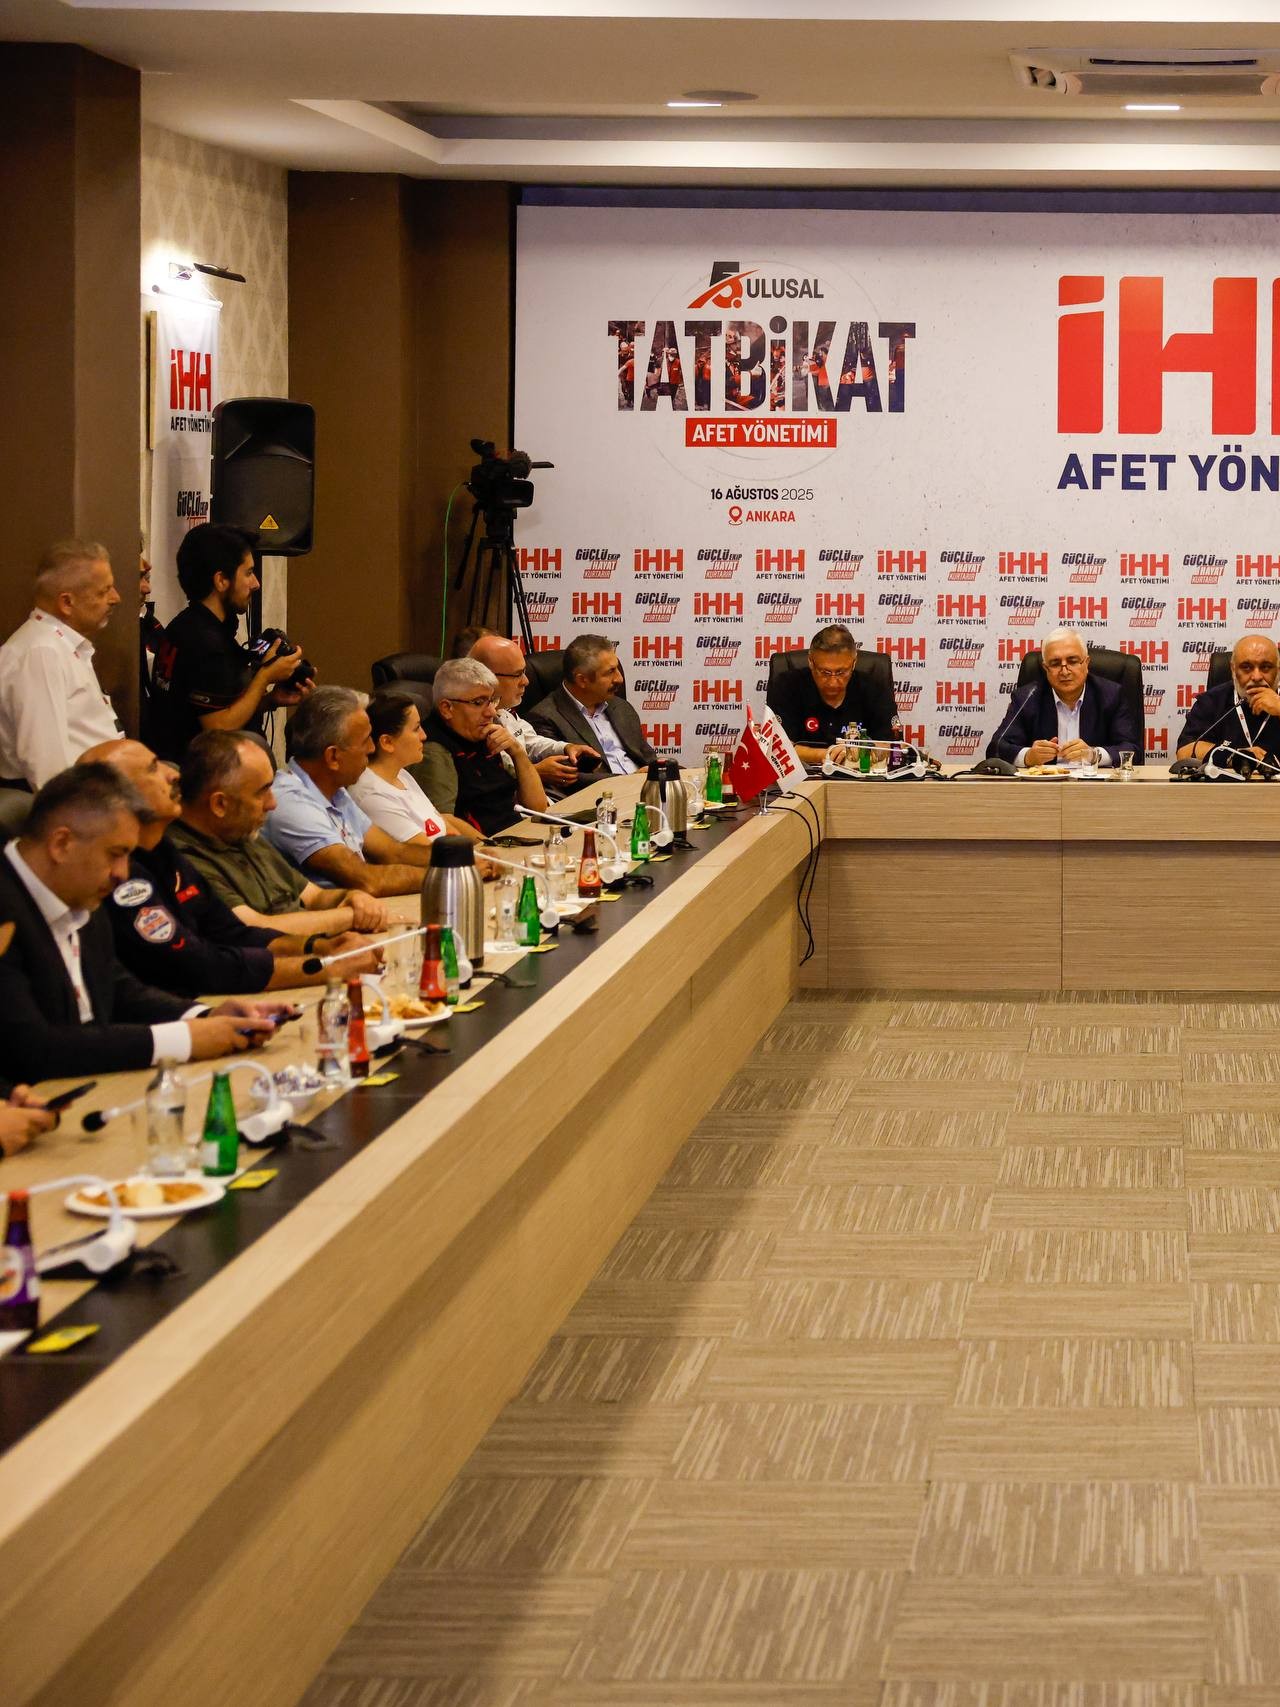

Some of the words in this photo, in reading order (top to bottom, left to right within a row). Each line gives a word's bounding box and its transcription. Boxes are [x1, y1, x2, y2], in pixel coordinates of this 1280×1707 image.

[746, 278, 824, 298] ULUSAL
[608, 316, 916, 412] TATBİKAT
[170, 416, 187, 431] AFET
[692, 424, 737, 442] AFET
[744, 420, 828, 442] YÖNETİMİ
[1057, 454, 1176, 491] AFET
[711, 488, 722, 500] 16
[726, 485, 779, 500] AĞUSTOS
[782, 489, 814, 500] 2025
[746, 510, 796, 522] ANKARA
[575, 549, 608, 562] GÜÇLÜ
[697, 549, 730, 562] GÜÇLÜ
[819, 550, 852, 562] GÜÇLÜ
[940, 551, 973, 564] GÜÇLÜ
[1061, 553, 1094, 566] GÜÇLÜ
[1183, 554, 1216, 566] GÜÇLÜ
[592, 561, 615, 570] HAYAT
[714, 561, 737, 570] HAYAT
[836, 562, 859, 571] HAYAT
[956, 563, 980, 572] HAYAT
[1078, 565, 1101, 574] HAYAT
[652, 571, 683, 579] YÖNETİMİ
[1200, 566, 1223, 575] HAYAT
[774, 571, 805, 580] YÖNETİMİ
[895, 573, 926, 581] YÖNETİMİ
[1017, 574, 1048, 582] YÖNETİMİ
[1138, 576, 1169, 584] YÖNETİMİ
[590, 615, 621, 623] YÖNETİMİ
[833, 615, 865, 624] YÖNETİMİ
[1076, 619, 1108, 627] YÖNETİMİ
[696, 636, 729, 648] GÜÇLÜ
[712, 648, 736, 657] HAYAT
[651, 658, 682, 667] YÖNETİMİ
[711, 702, 742, 710] YÖNETİMİ
[954, 704, 986, 712] YÖNETİMİ
[938, 726, 971, 738] GÜÇLÜ
[954, 738, 978, 747] HAYAT
